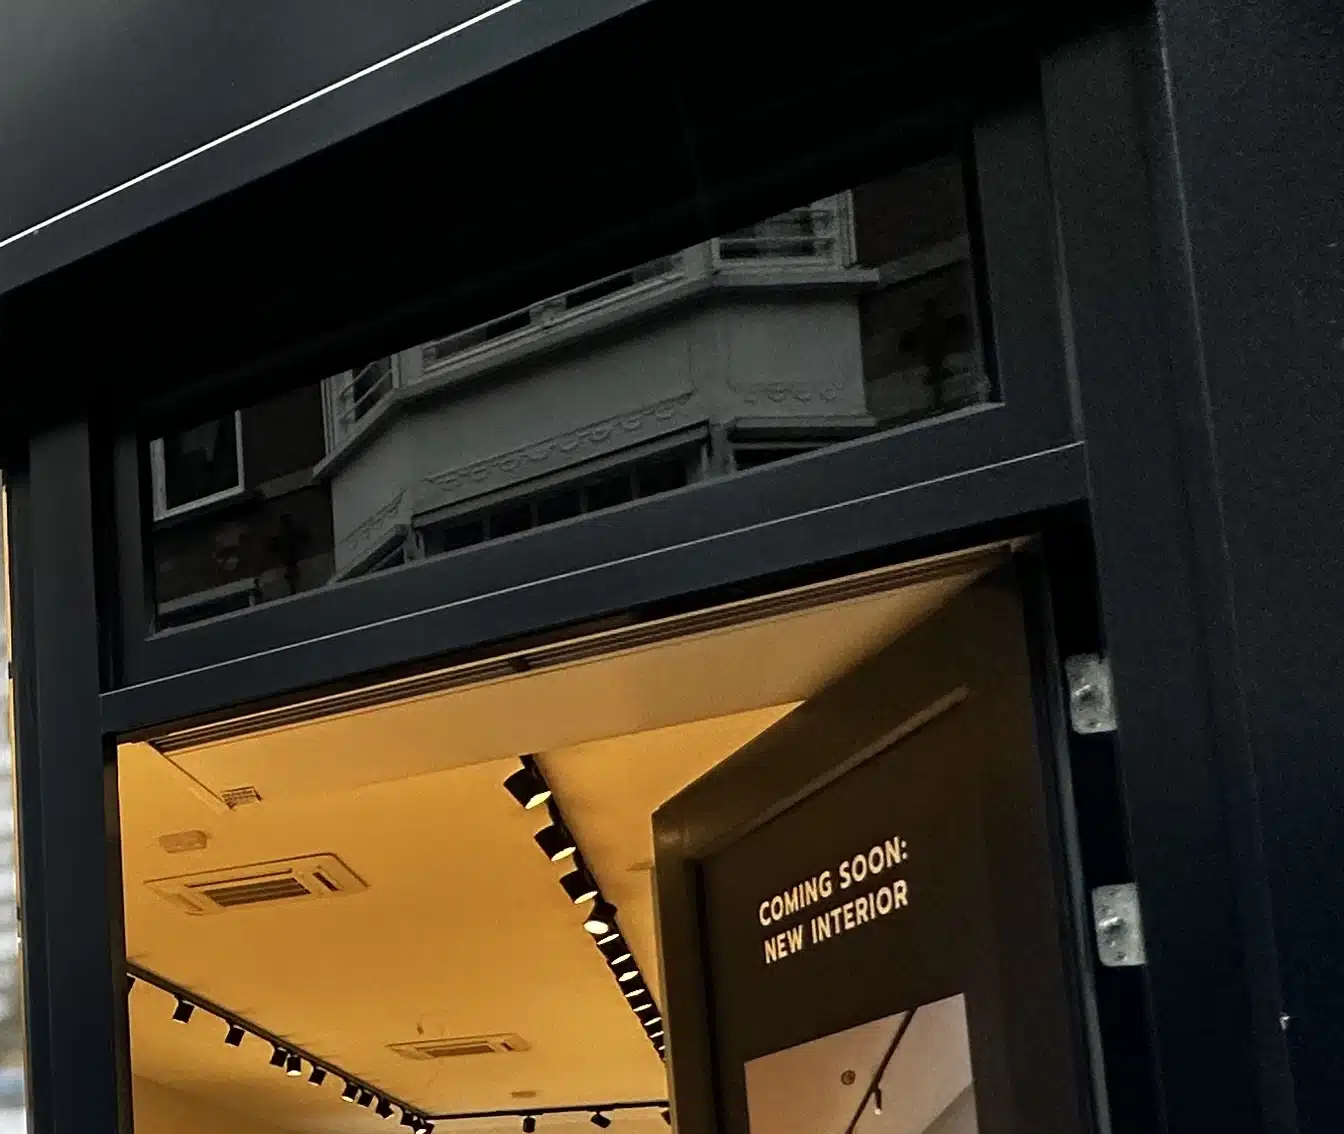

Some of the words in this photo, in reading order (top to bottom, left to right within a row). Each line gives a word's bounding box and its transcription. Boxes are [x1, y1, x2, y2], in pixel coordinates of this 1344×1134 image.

[759, 870, 832, 926] COMING
[839, 836, 908, 889] SOON:
[764, 924, 803, 964] NEW
[811, 879, 908, 944] INTERIOR
